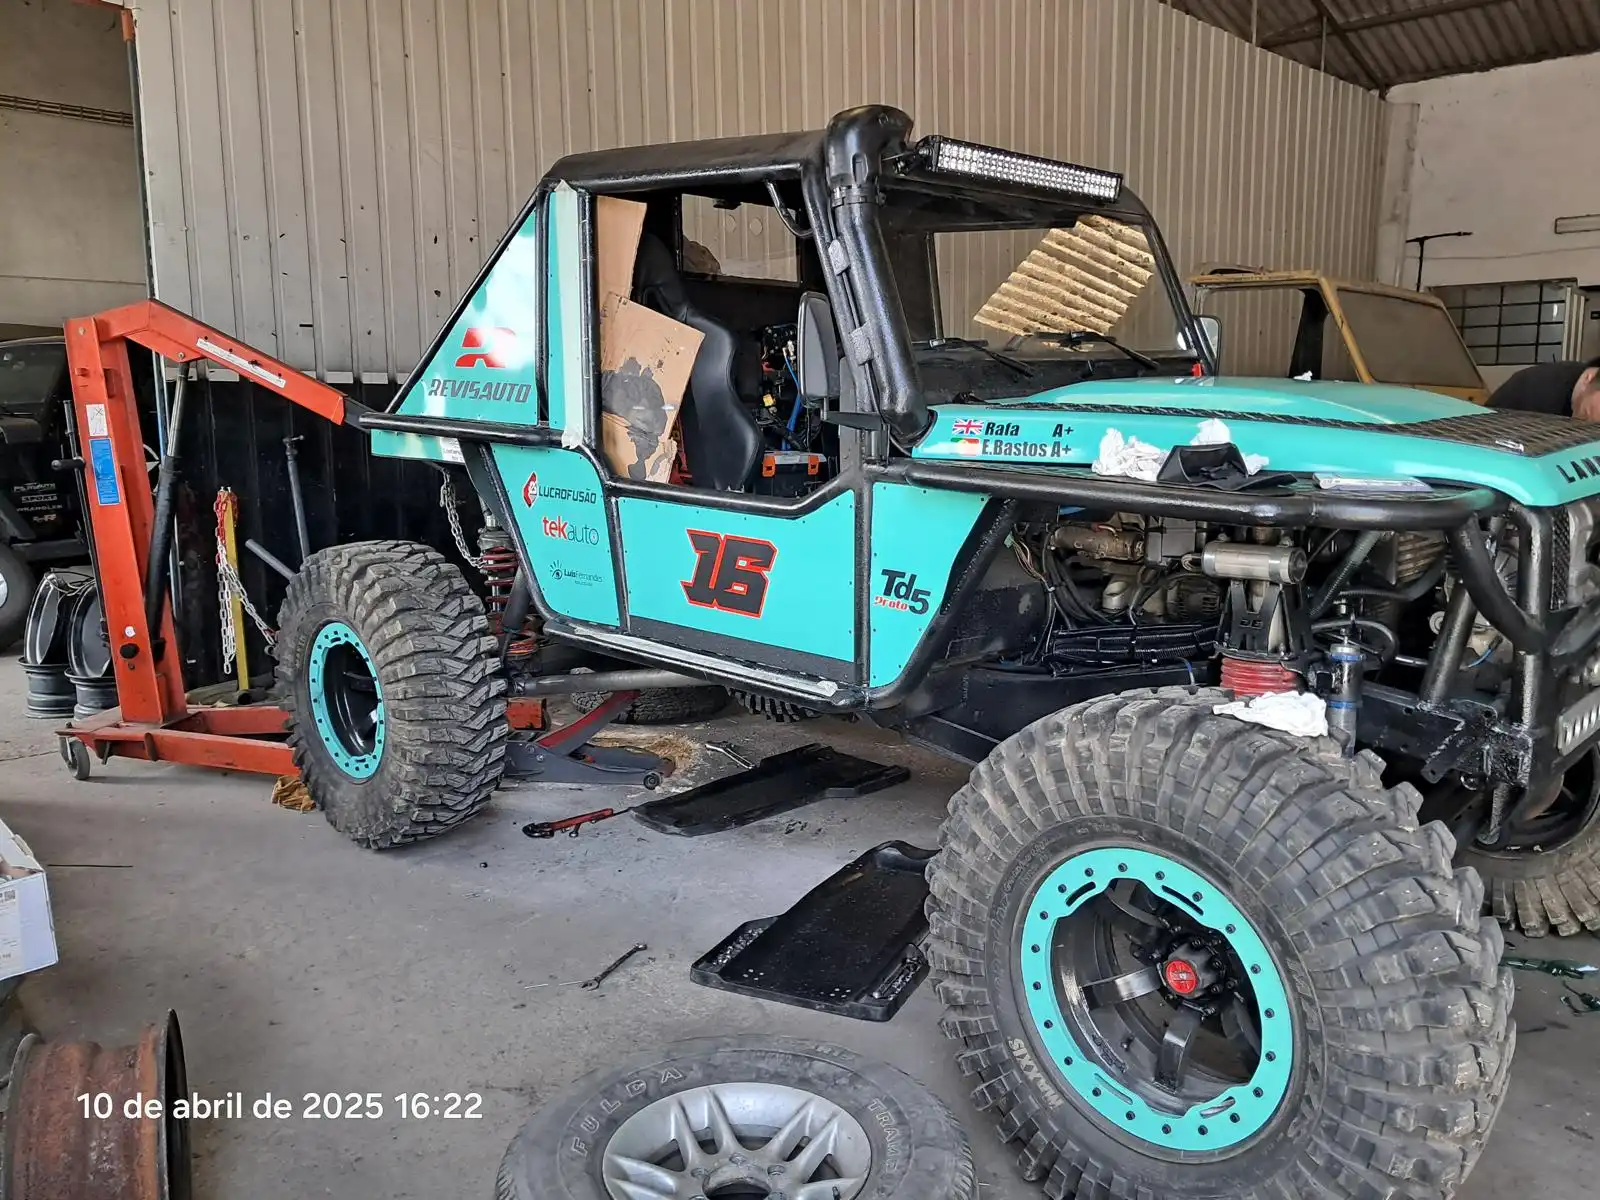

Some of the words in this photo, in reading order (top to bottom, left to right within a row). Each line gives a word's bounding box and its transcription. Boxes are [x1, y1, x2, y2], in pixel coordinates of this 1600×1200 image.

[428, 379, 532, 403] REVISAUTO
[985, 422, 1020, 436] Rafa
[1052, 424, 1074, 438] A+
[1050, 441, 1072, 458] A+
[538, 486, 597, 504] LUCROFUSÃO
[542, 516, 600, 545] tekauto
[680, 528, 778, 618] 16
[881, 568, 931, 614] Td5
[571, 1066, 683, 1157] FULDA
